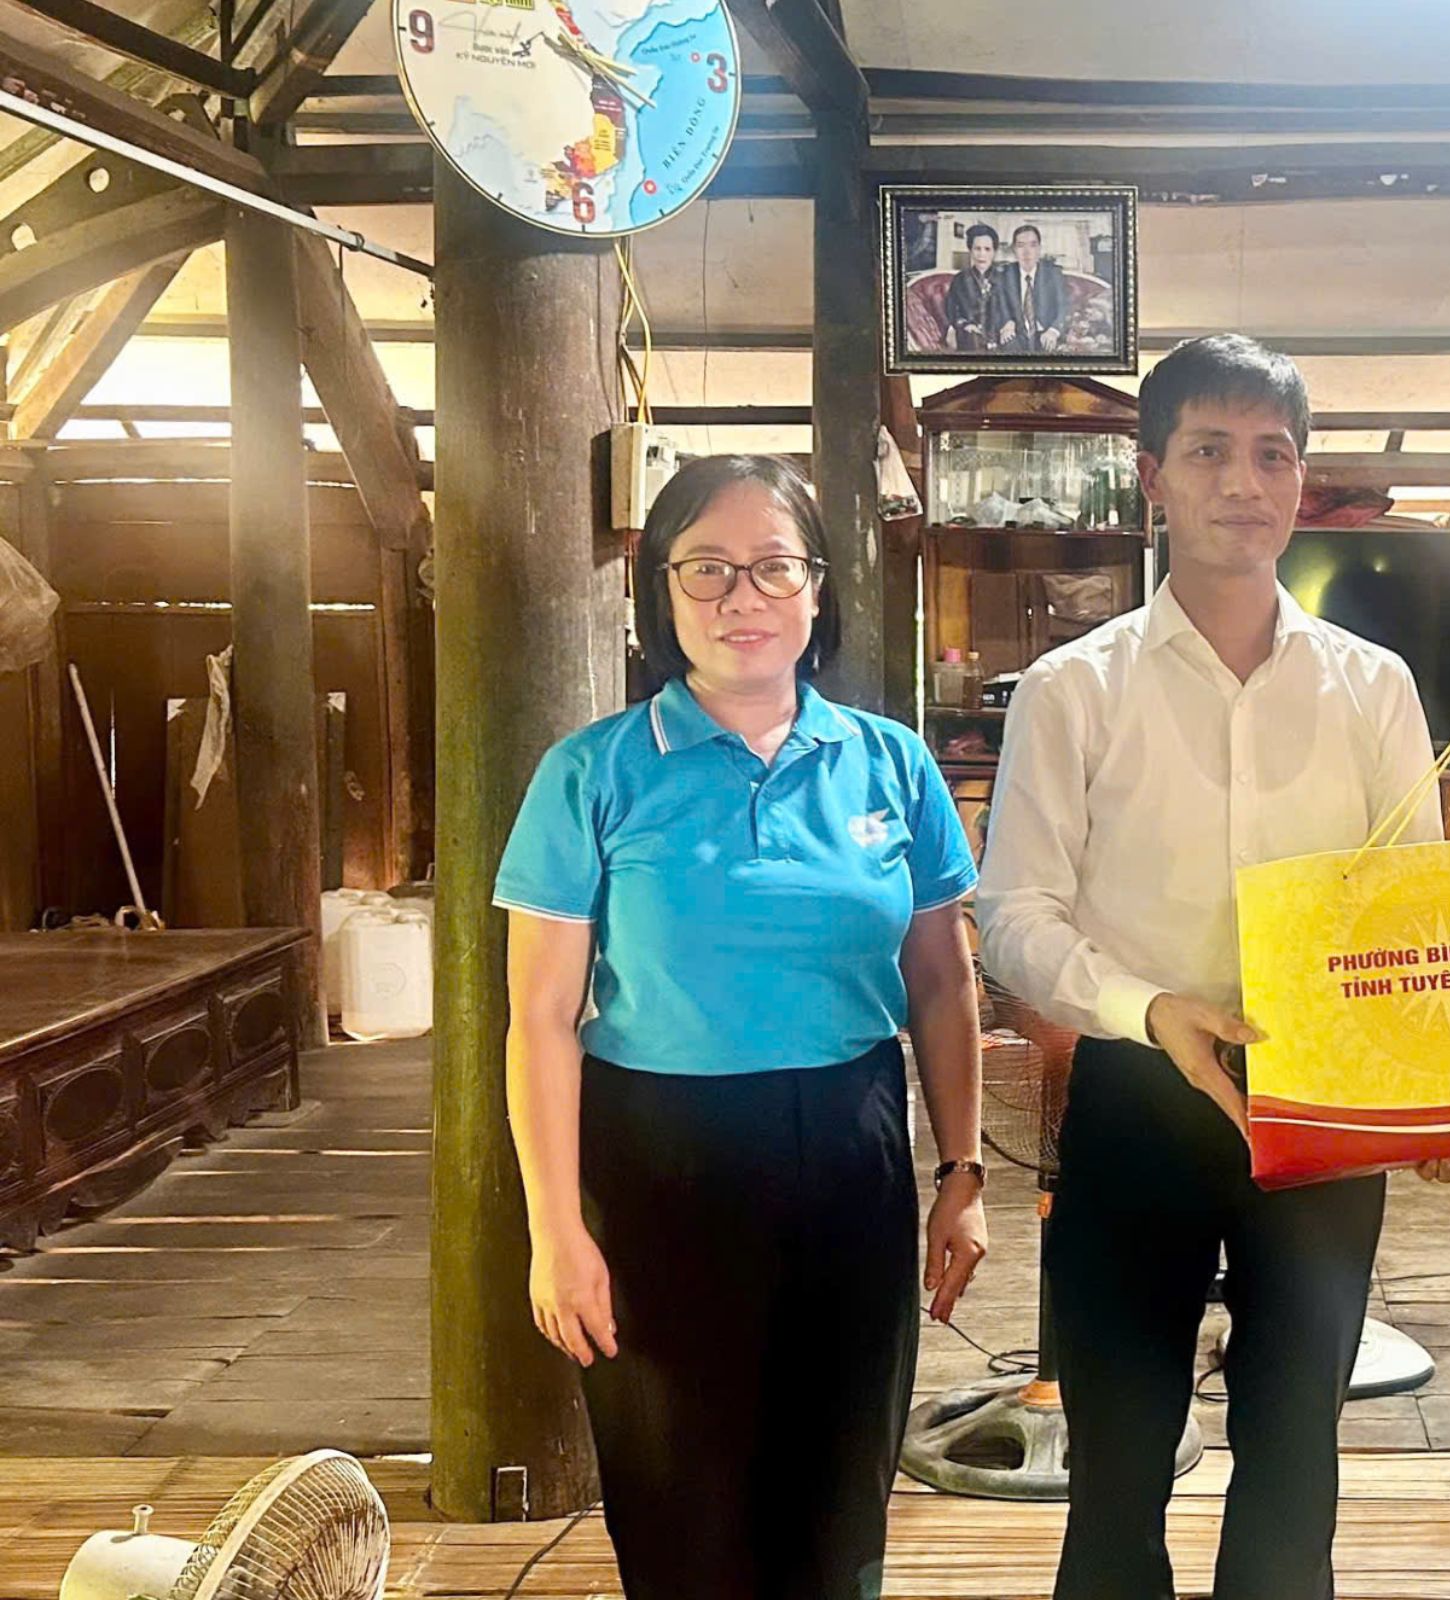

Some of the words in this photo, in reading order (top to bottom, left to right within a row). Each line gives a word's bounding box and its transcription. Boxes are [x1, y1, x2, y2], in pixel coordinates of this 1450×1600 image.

[408, 9, 435, 54] 9
[706, 53, 729, 94] 3
[571, 181, 596, 224] 6
[1327, 948, 1419, 972] PHƯỜNG
